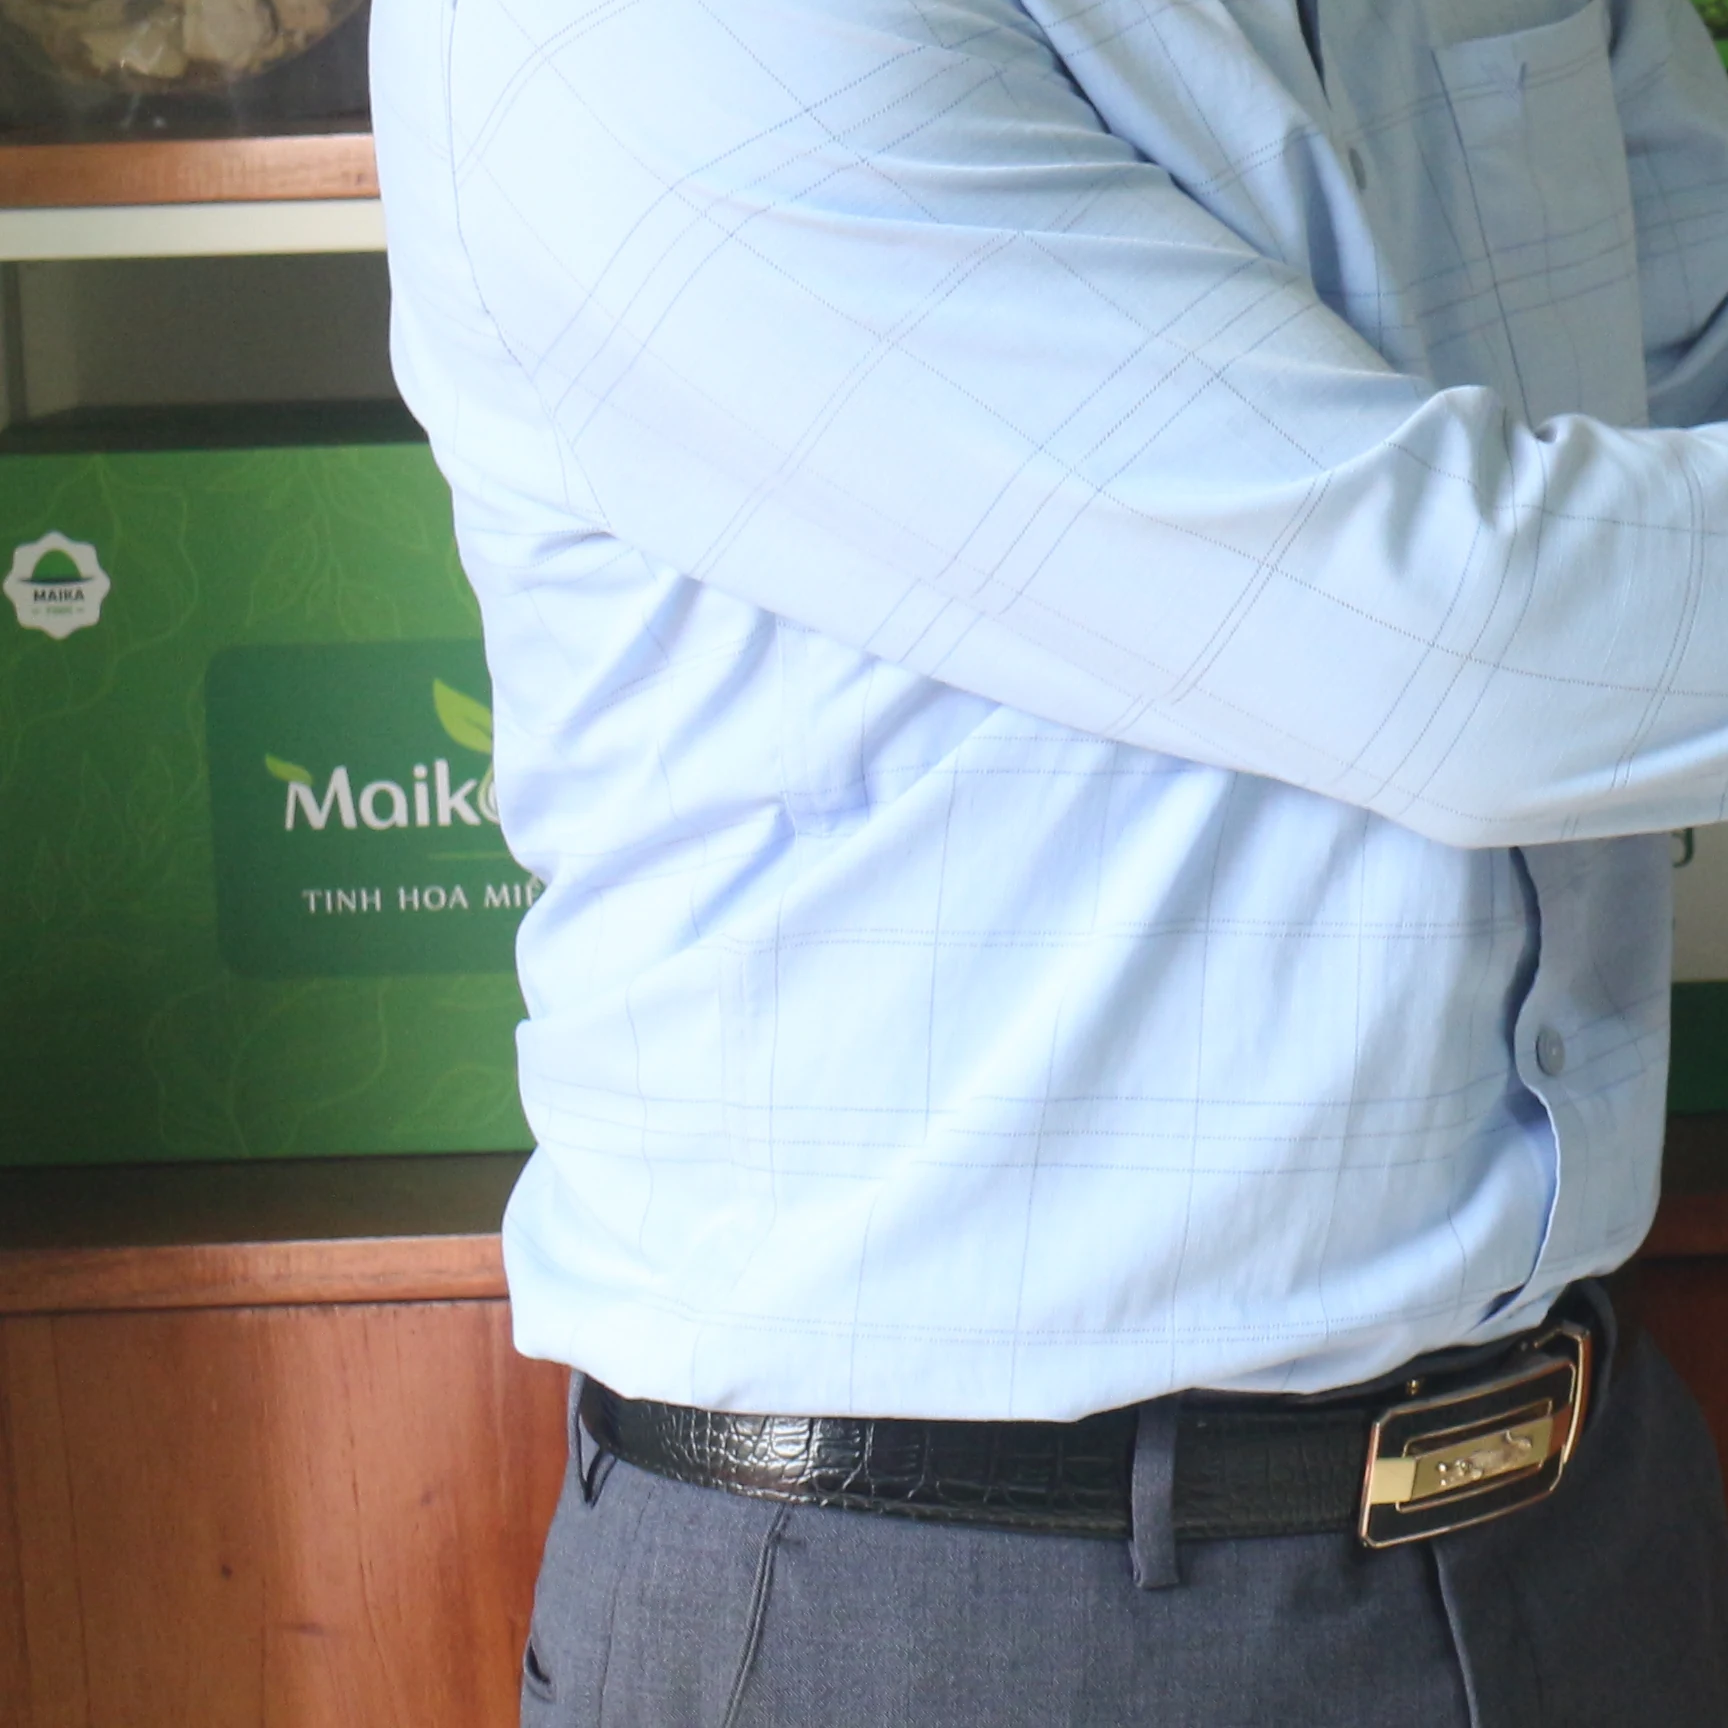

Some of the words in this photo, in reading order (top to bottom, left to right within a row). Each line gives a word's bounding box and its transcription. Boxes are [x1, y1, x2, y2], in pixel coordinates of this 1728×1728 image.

[33, 588, 85, 603] MAIKA
[302, 887, 383, 915] TINH
[399, 884, 469, 911] HOA
